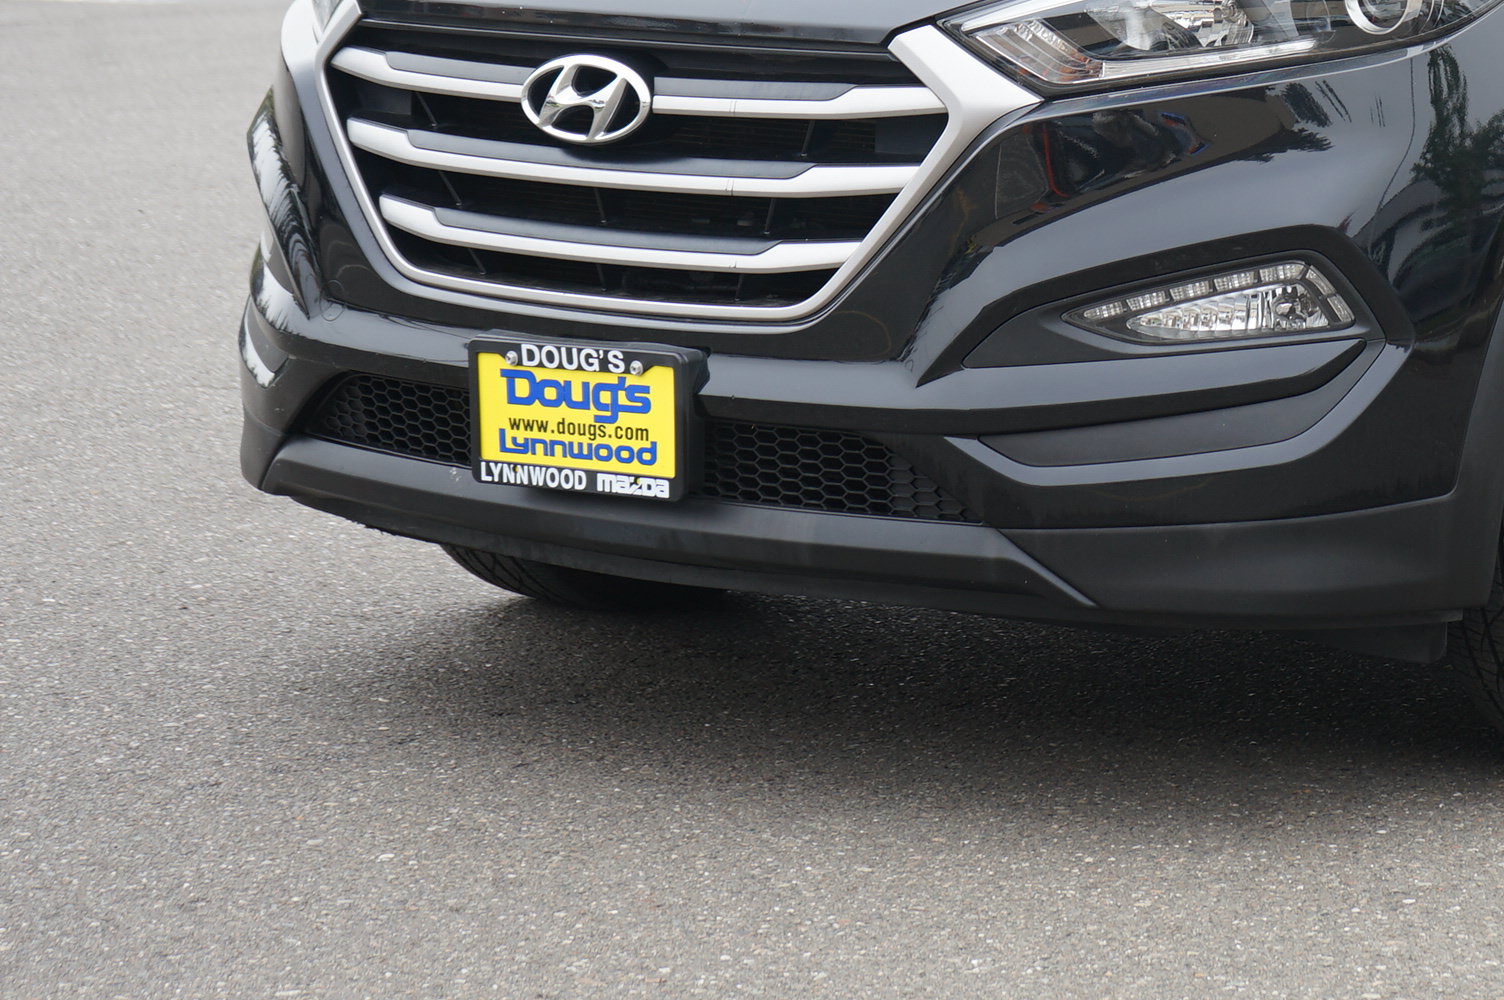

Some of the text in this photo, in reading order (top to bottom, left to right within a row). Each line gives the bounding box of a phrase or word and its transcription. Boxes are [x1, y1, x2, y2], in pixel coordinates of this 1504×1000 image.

[521, 344, 625, 373] DOUG'S
[509, 417, 649, 441] www.dougs.com
[499, 428, 657, 466] Lynnwood
[481, 462, 587, 490] LYNNWOOD
